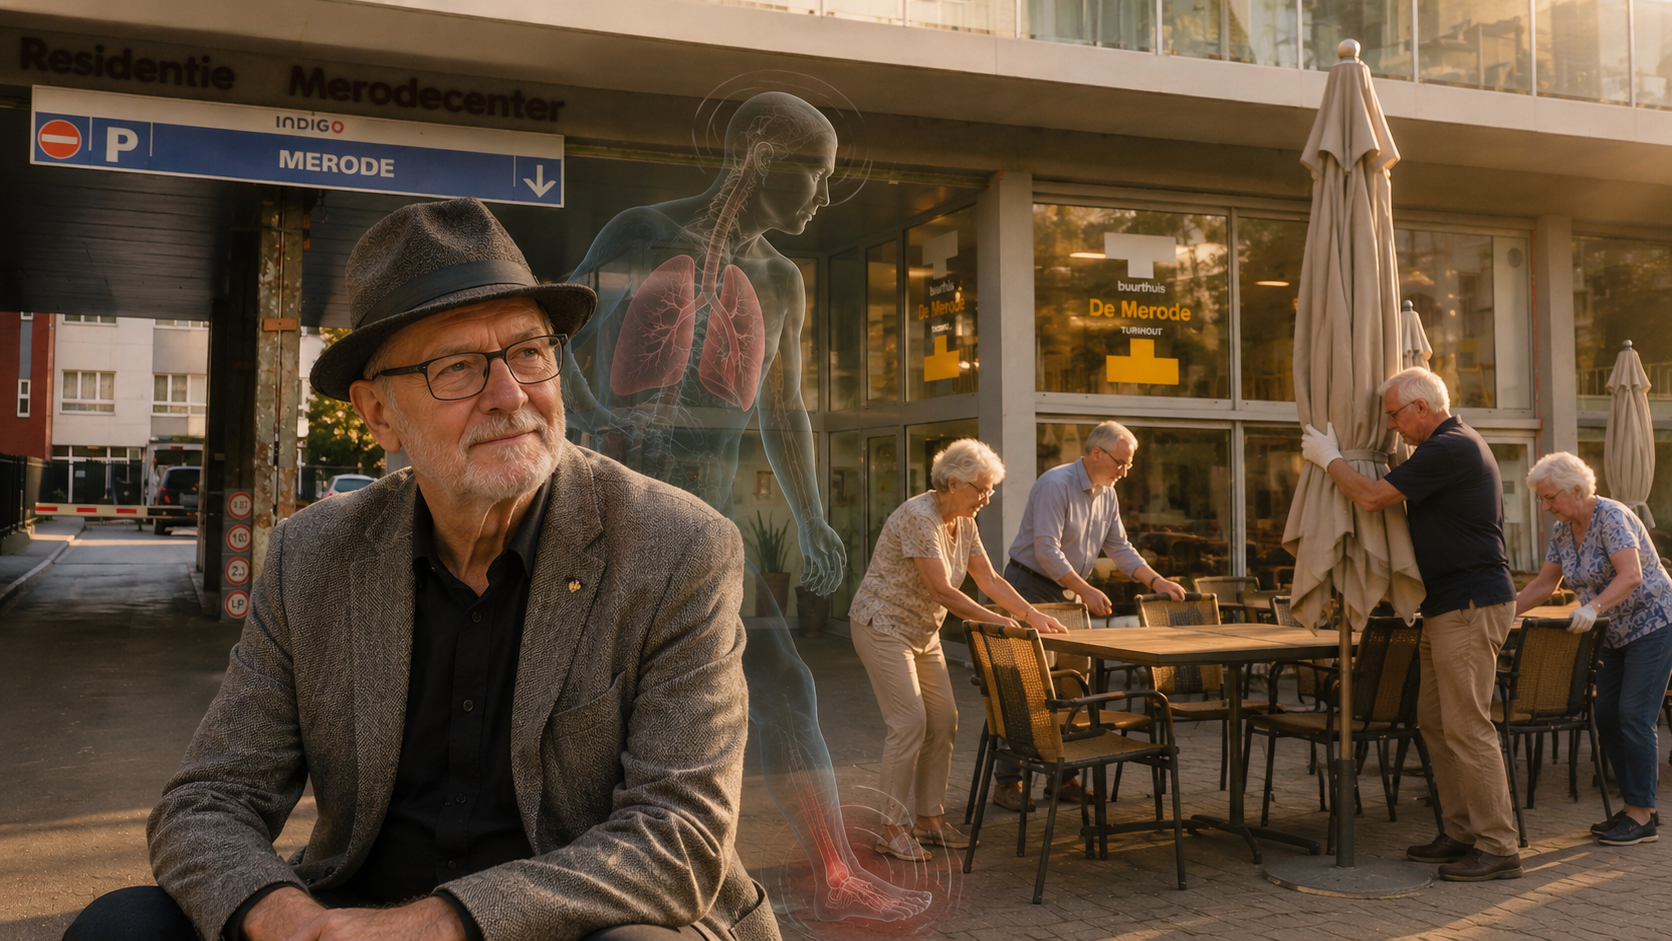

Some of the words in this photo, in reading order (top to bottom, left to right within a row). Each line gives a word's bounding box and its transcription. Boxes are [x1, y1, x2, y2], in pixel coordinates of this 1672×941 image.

[20, 36, 236, 91] Residentie
[288, 65, 565, 123] Merodecenter
[276, 115, 345, 134] INDIGO
[106, 126, 139, 163] P
[279, 149, 395, 178] MERODE
[1117, 280, 1166, 294] buurthuis
[1089, 298, 1115, 318] De
[1121, 300, 1192, 321] Merode
